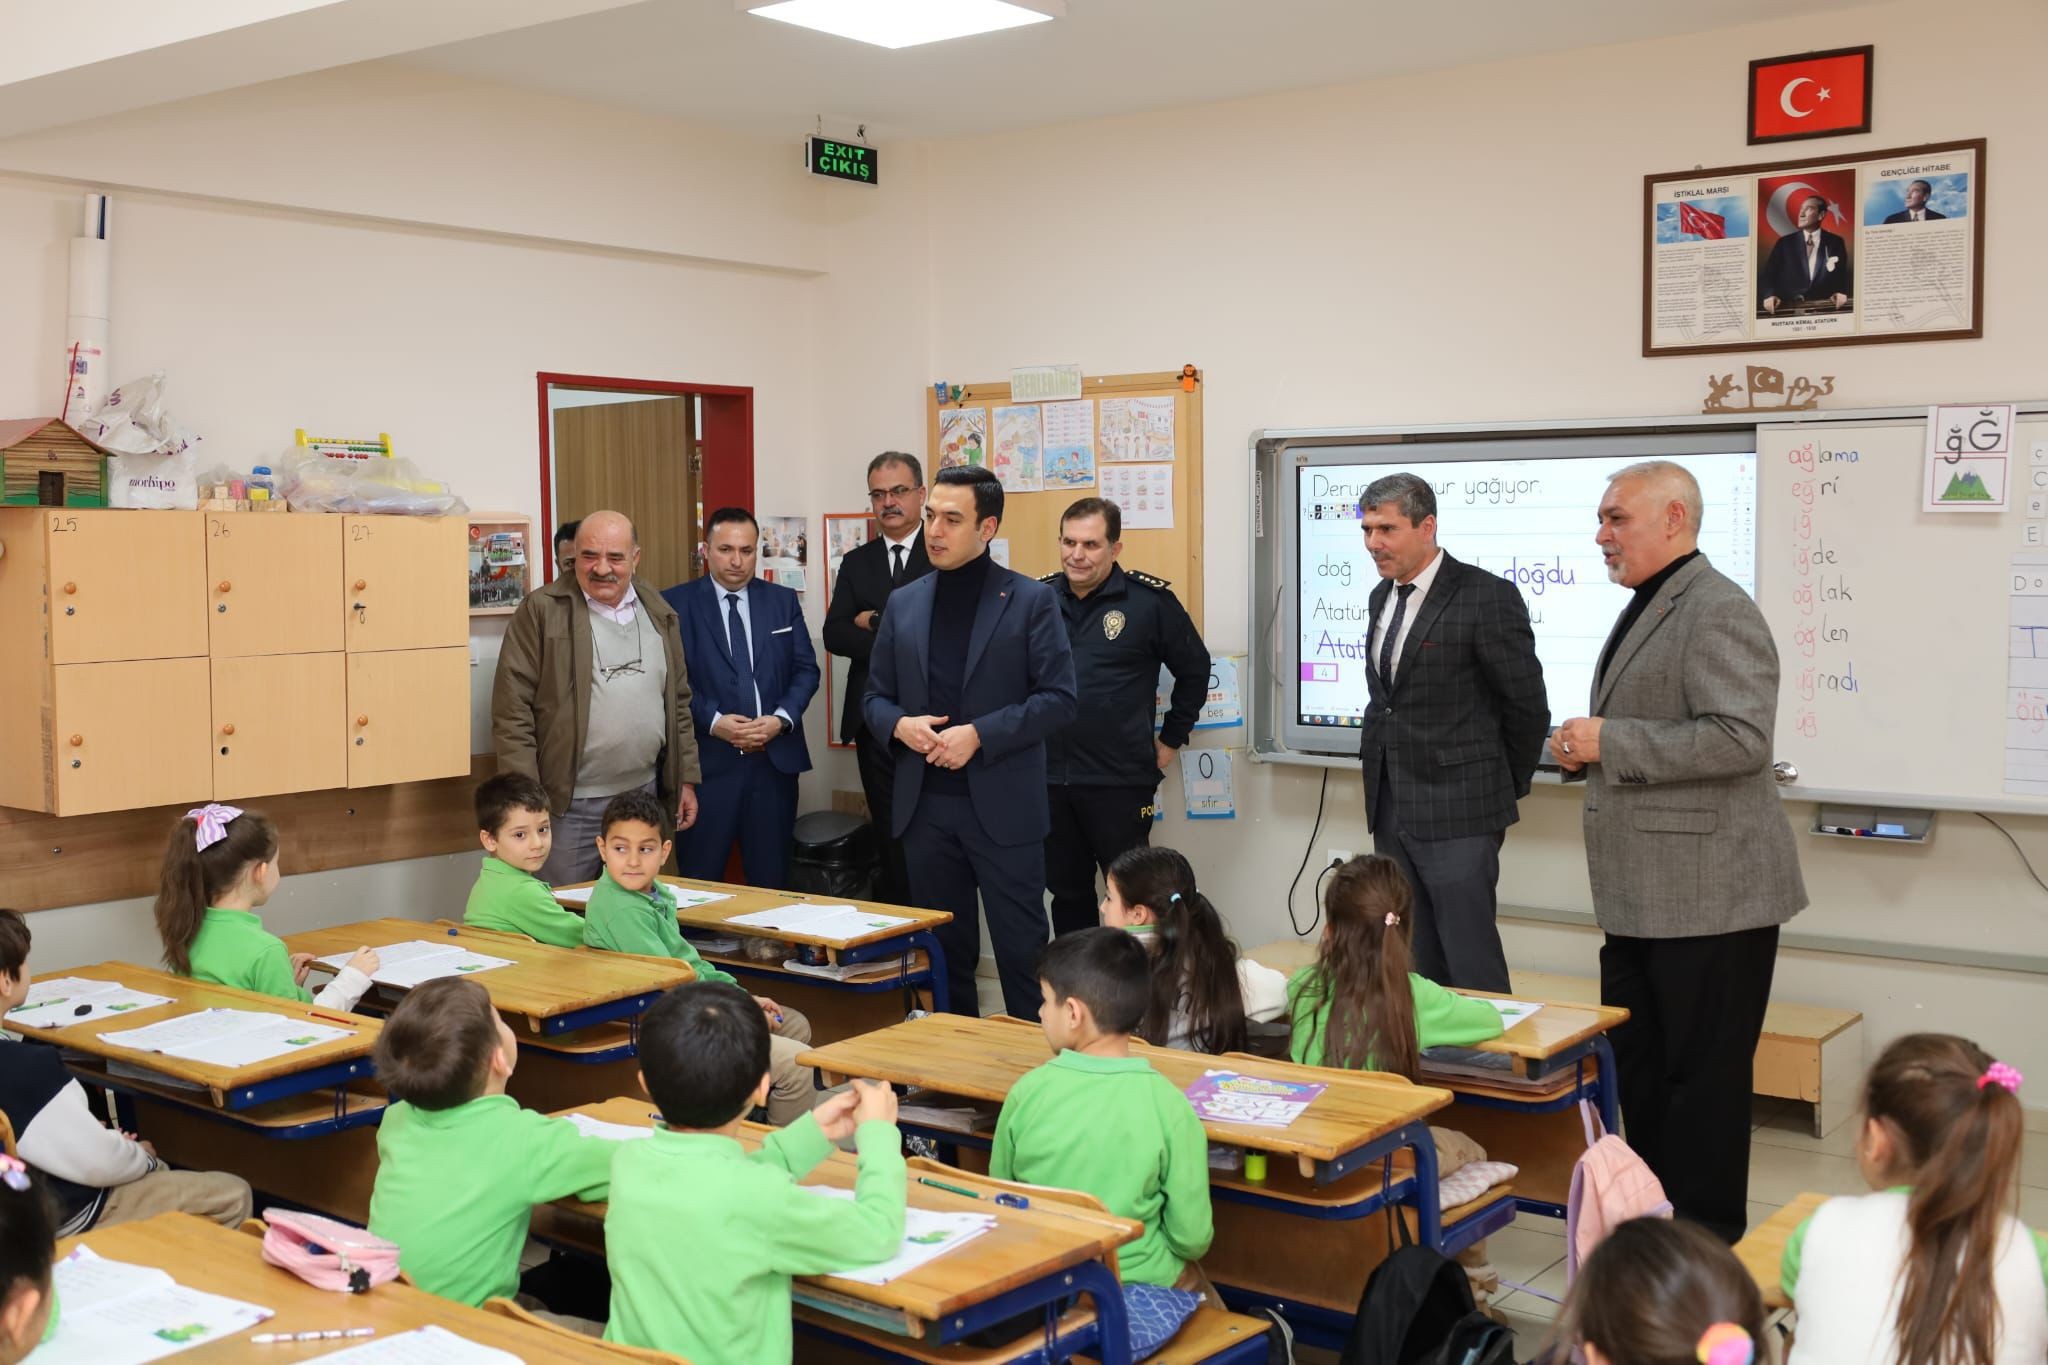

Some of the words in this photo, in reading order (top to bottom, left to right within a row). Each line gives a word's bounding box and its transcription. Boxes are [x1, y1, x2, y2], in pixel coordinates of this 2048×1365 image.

[824, 143, 865, 160] EXIT
[820, 157, 869, 180] ÇIKIŞ
[1922, 163, 1951, 173] HİTABE
[129, 476, 175, 491] morhipo
[53, 517, 77, 532] 25
[211, 520, 231, 537] 26
[352, 525, 373, 541] 27
[2027, 526, 2038, 542] E
[1317, 553, 1351, 587] doğ
[1313, 597, 1371, 621] Atatür
[1317, 629, 1368, 660] Atat
[1207, 707, 1224, 719] beş
